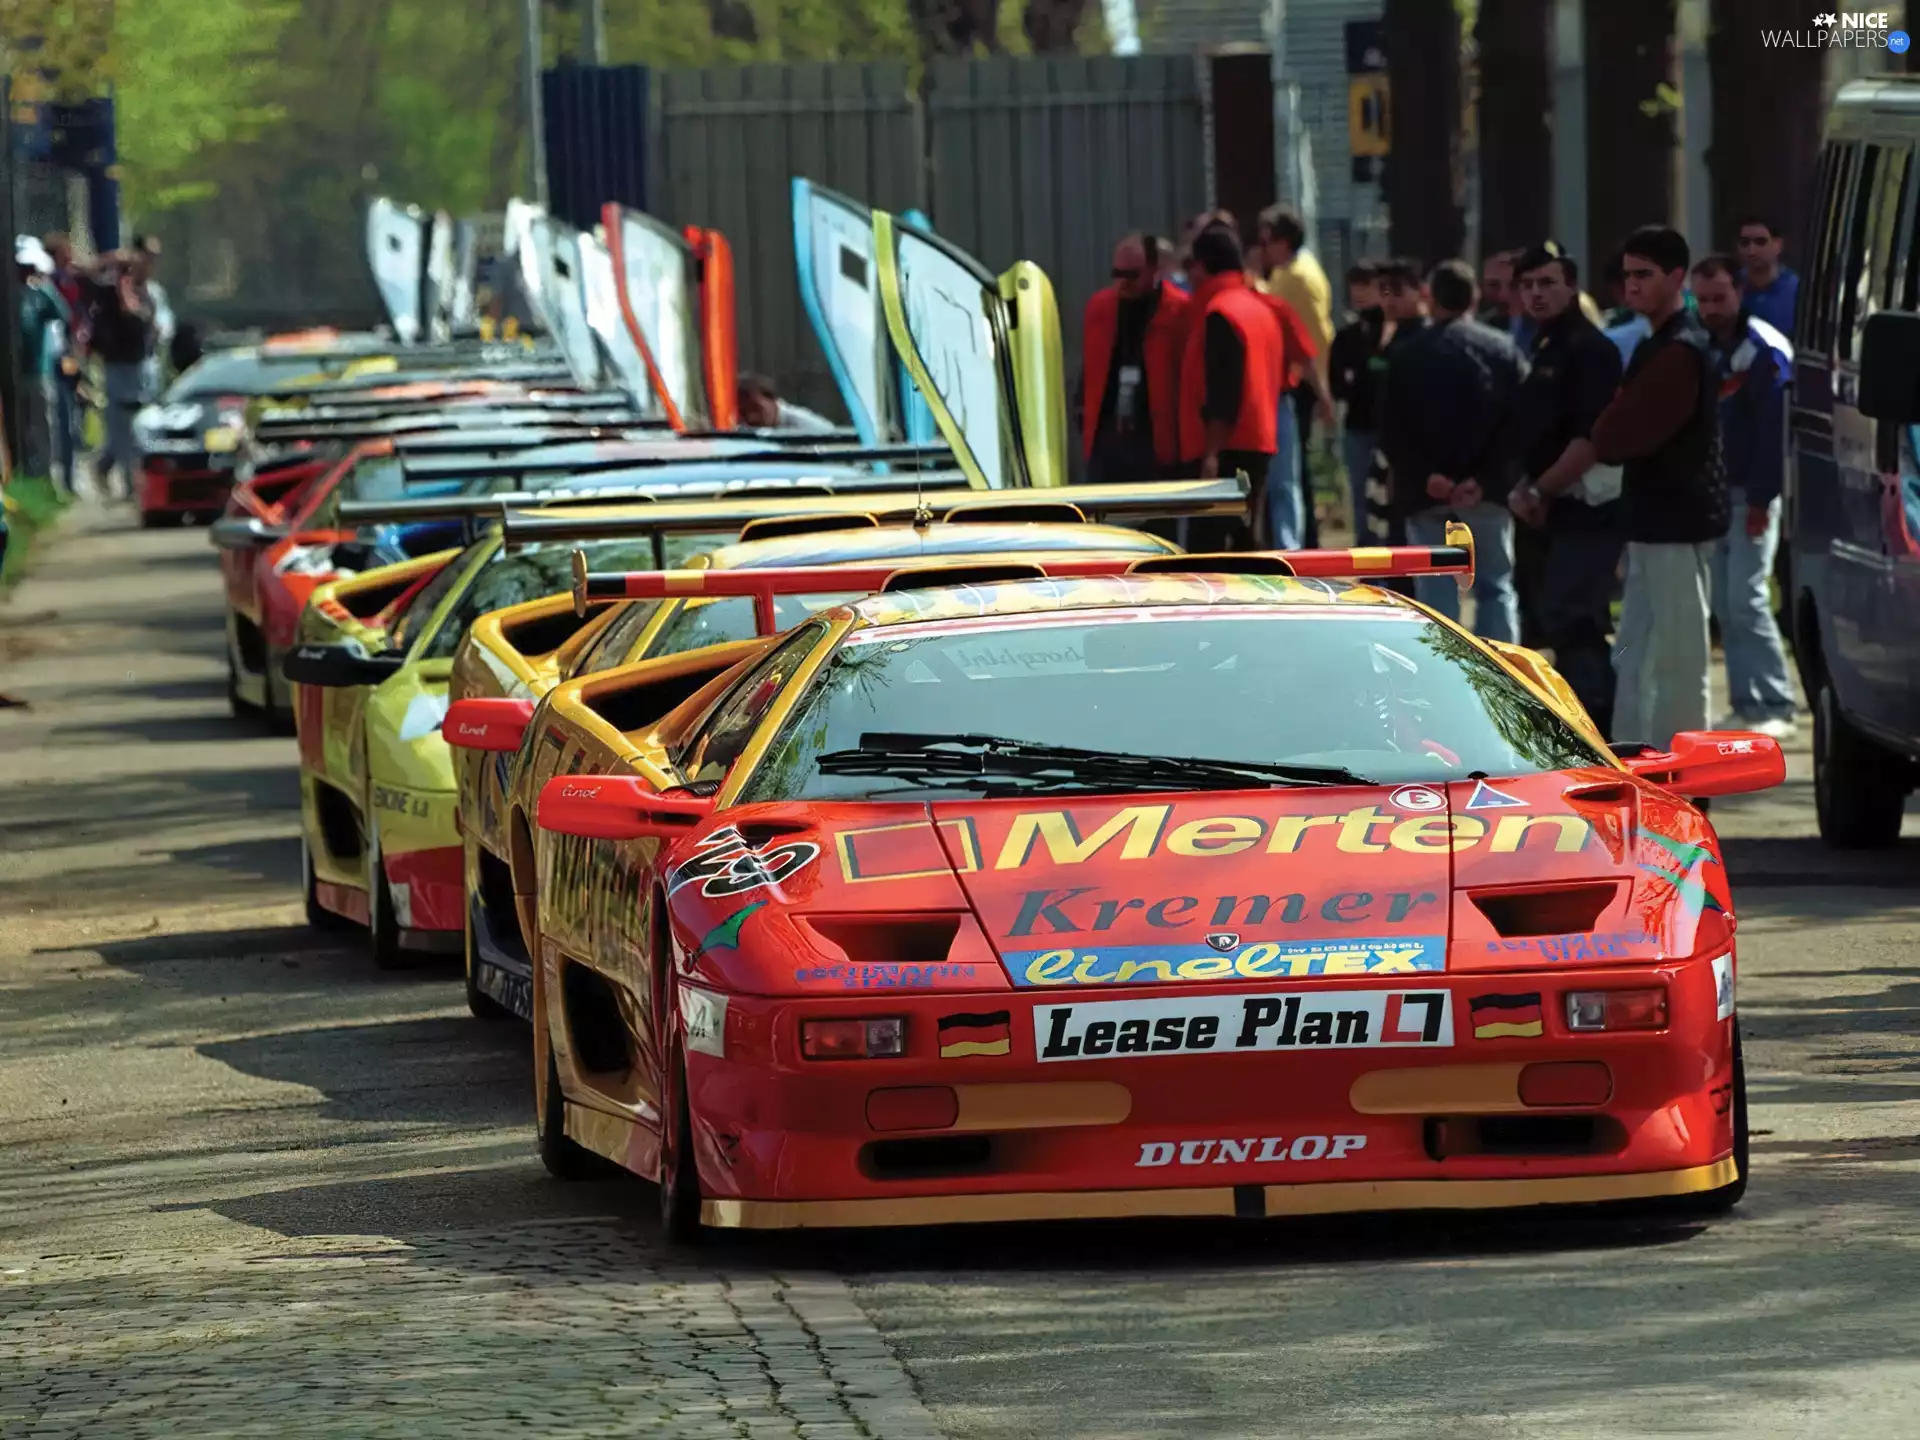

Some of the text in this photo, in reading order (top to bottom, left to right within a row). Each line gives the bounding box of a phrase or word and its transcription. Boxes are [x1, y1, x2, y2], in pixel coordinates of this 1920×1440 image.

[994, 804, 1594, 870] Merten
[1003, 886, 1437, 938] Kremer
[1042, 1007, 1219, 1059] Lease
[1236, 996, 1371, 1046] Plan
[1134, 1135, 1368, 1167] DUNLOP
